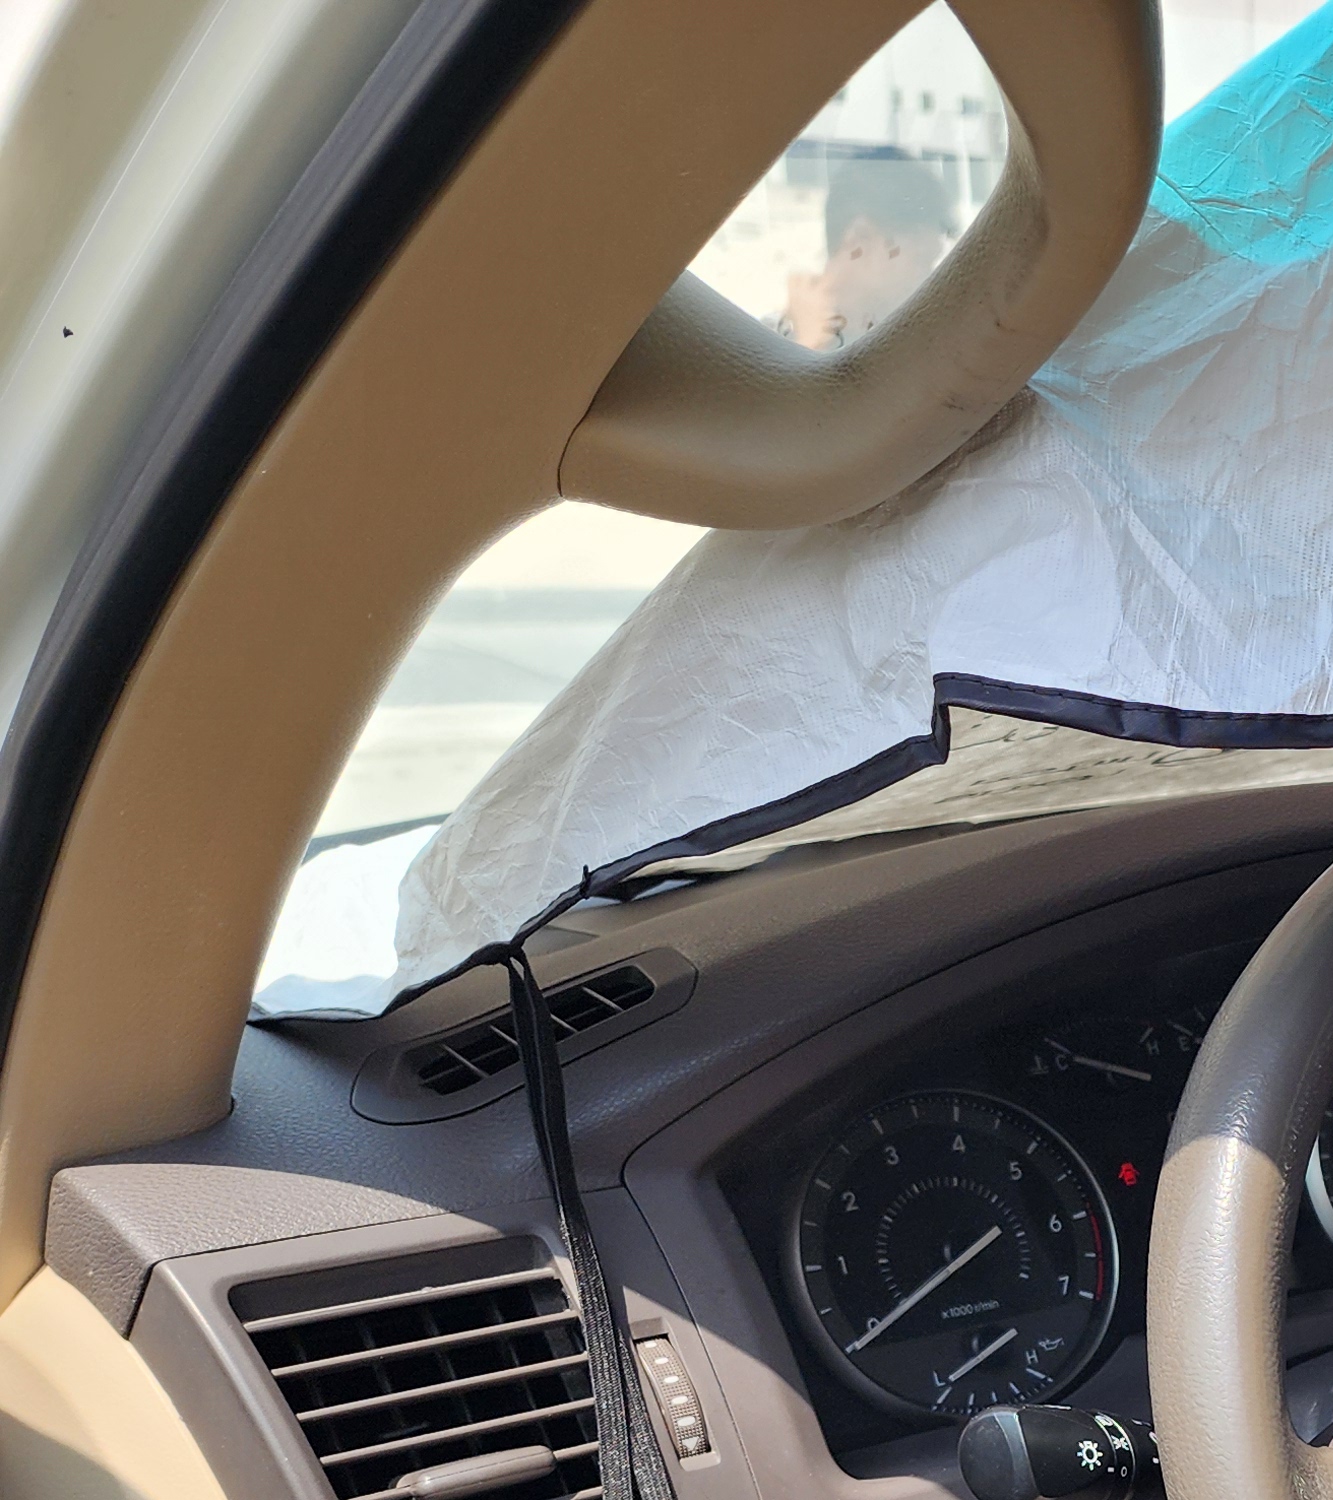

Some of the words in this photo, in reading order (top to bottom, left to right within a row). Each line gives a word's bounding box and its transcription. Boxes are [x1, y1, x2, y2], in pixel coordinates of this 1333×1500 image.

[952, 1135, 966, 1153] 4
[885, 1146, 899, 1165] 3
[1009, 1161, 1023, 1180] 5
[842, 1192, 859, 1211] 2
[1049, 1214, 1063, 1233] 6
[838, 1255, 848, 1275] 1
[1058, 1275, 1070, 1295] 7
[1025, 1348, 1039, 1365] H
[933, 1371, 946, 1387] L
